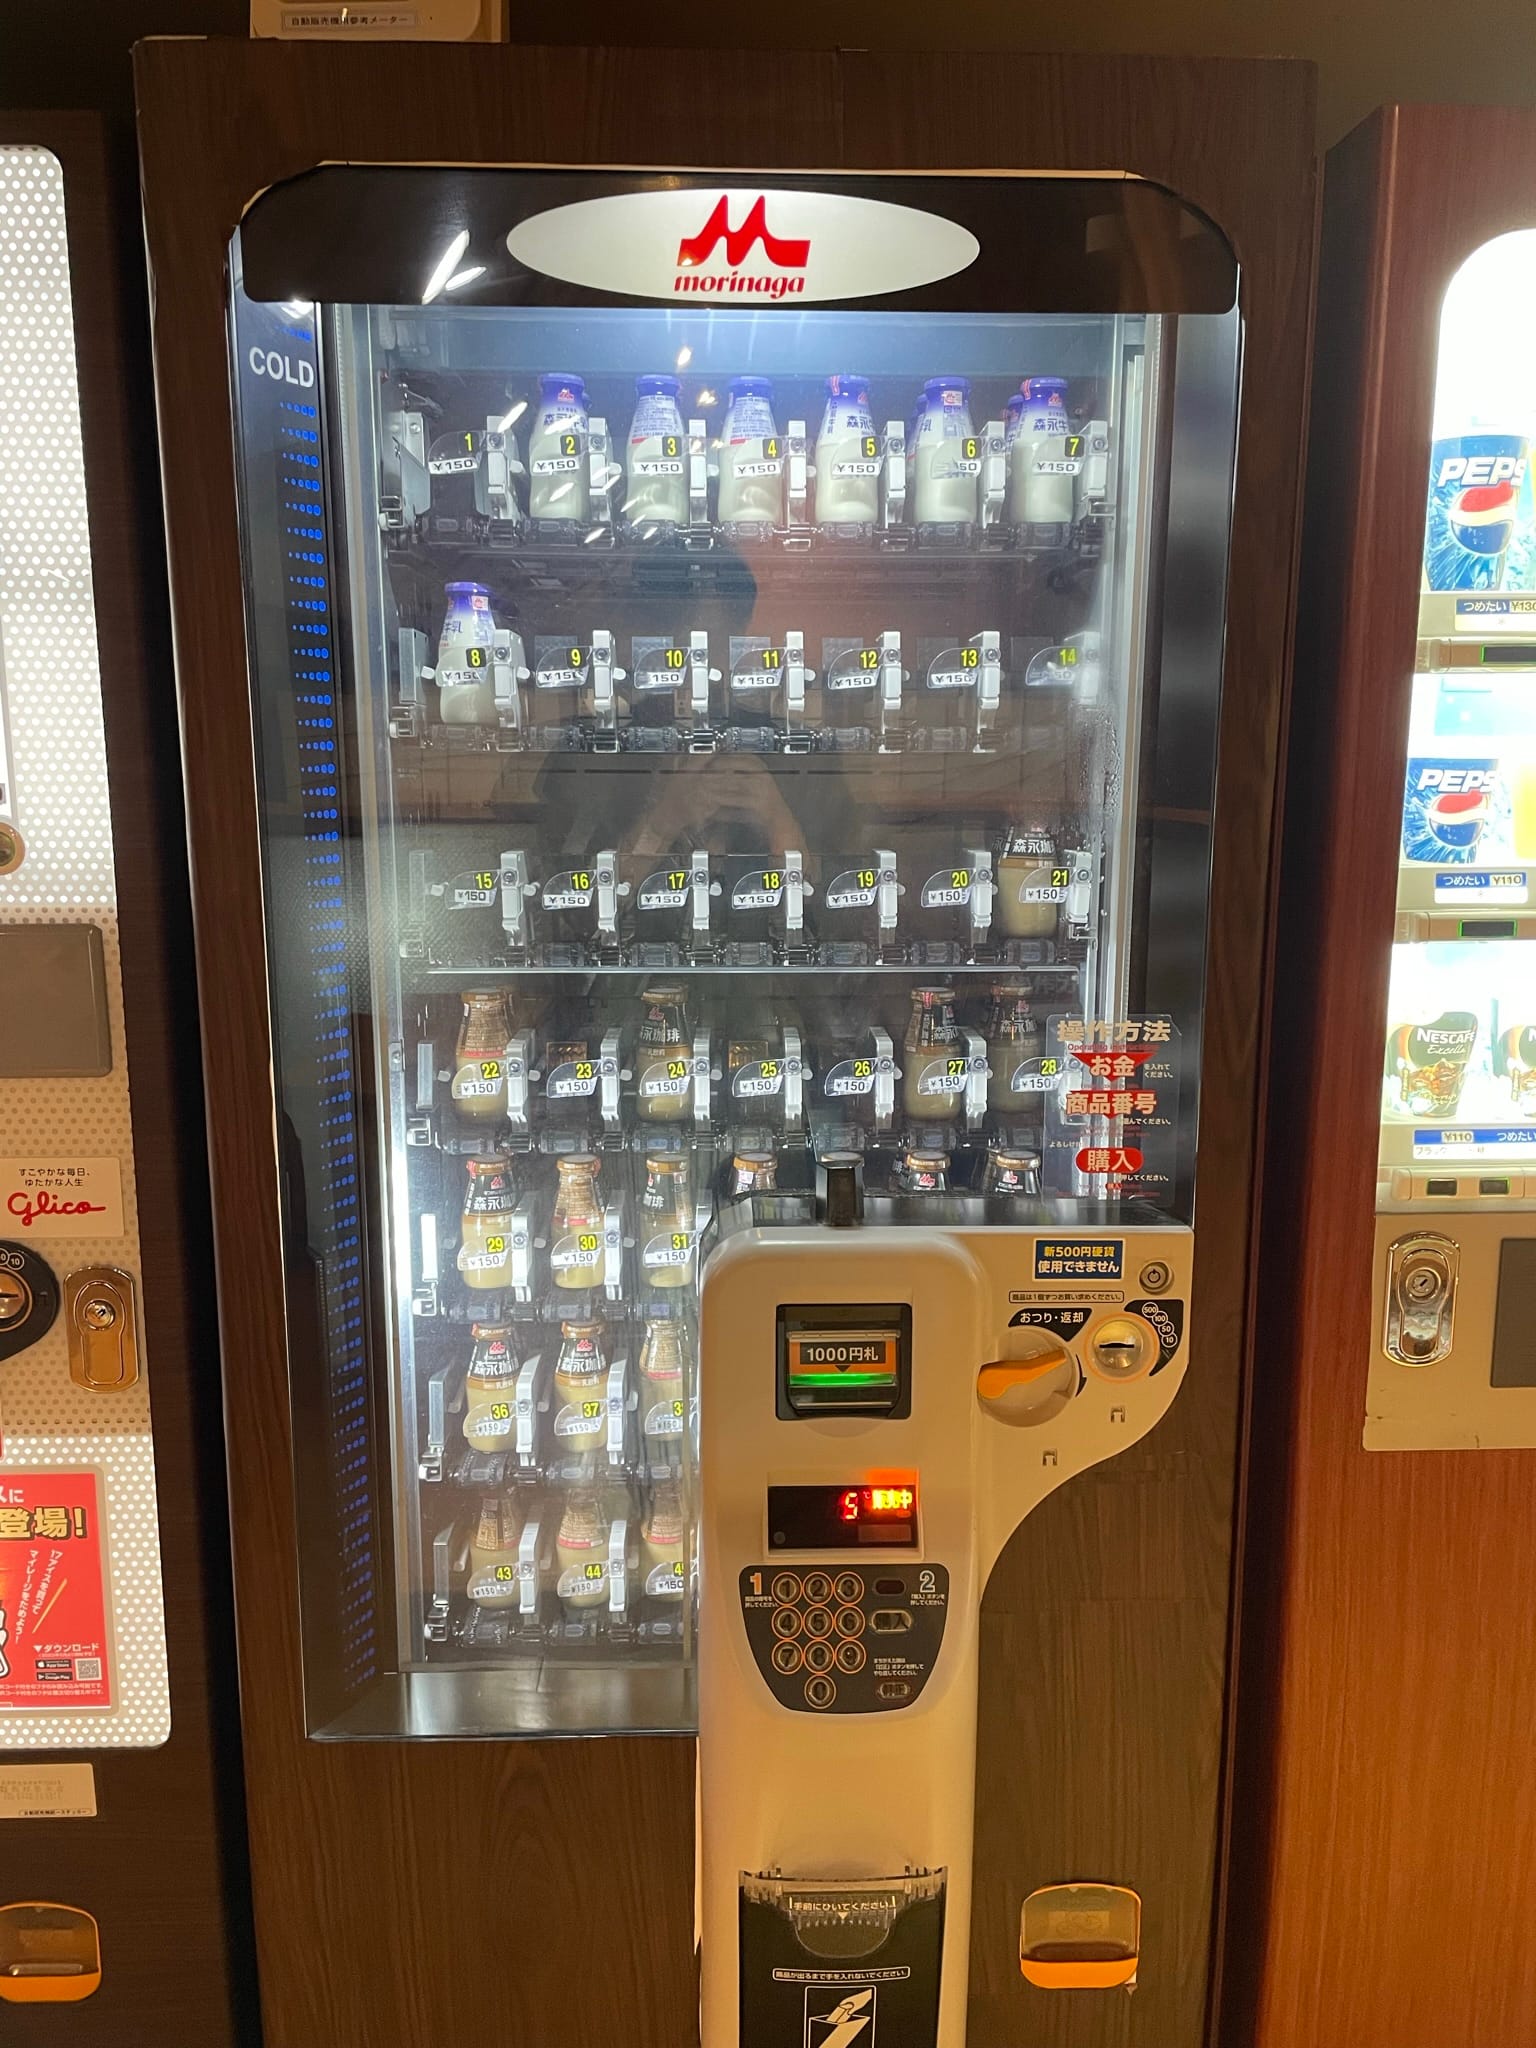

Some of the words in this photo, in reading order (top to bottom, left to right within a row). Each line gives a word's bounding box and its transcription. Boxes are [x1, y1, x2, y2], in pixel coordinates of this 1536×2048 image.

[674, 270, 805, 300] morinaga
[249, 346, 315, 388] COLD
[464, 432, 473, 452] 1
[565, 436, 576, 455] 2
[667, 437, 677, 456] 3
[767, 438, 777, 458] 4
[866, 438, 876, 456] 5
[966, 439, 977, 458] 6
[1069, 437, 1079, 457] 7
[1463, 600, 1507, 612] つめたい
[471, 649, 481, 667] 8
[571, 649, 581, 666] 9
[665, 649, 683, 668] 10
[763, 651, 779, 669] 11
[860, 650, 877, 669] 12
[961, 650, 977, 668] 13
[1060, 648, 1076, 666] 14
[475, 872, 493, 889] 15
[571, 872, 589, 889] 16
[668, 872, 685, 889] 17
[763, 872, 780, 890] 18
[857, 871, 874, 888] 19
[951, 871, 969, 888] 20
[1052, 870, 1068, 886] 21
[1442, 874, 1486, 886] つめたい
[1057, 1020, 1171, 1042] 操作方法
[481, 1062, 499, 1079] 22
[576, 1063, 593, 1079] 23
[668, 1062, 686, 1079] 24
[760, 1062, 777, 1077] 25
[854, 1060, 871, 1077] 26
[948, 1060, 964, 1075] 27
[1040, 1059, 1057, 1075] 28
[1090, 1055, 1136, 1077] お金
[1066, 1092, 1157, 1116] 商品番号
[1087, 1149, 1135, 1172] 購入
[24, 1178, 84, 1188] ゆたかな人生
[487, 1237, 505, 1253] 29
[579, 1235, 596, 1251] 30
[672, 1235, 688, 1249] 31
[1044, 1246, 1115, 1258] 新500円硬貨
[11, 1258, 21, 1266] 10
[1038, 1260, 1120, 1274] 使用できません
[1020, 1311, 1084, 1324] おつり・返却
[1143, 1306, 1158, 1315] 500
[1154, 1314, 1167, 1323] 100
[1161, 1325, 1171, 1333] 50
[1165, 1336, 1175, 1344] 10
[807, 1346, 879, 1362] 1000円札
[491, 1403, 510, 1419] 36
[583, 1402, 600, 1418] 37
[496, 1566, 512, 1580] 43
[585, 1564, 602, 1578] 44
[750, 1572, 763, 1596] 1
[783, 1580, 792, 1599] 1
[812, 1579, 825, 1598] 2
[844, 1579, 856, 1598] 3
[919, 1569, 936, 1593] 2
[781, 1612, 793, 1632] 4
[813, 1612, 825, 1632] 5
[44, 1643, 100, 1653] ダウンロード
[781, 1648, 795, 1668] 7
